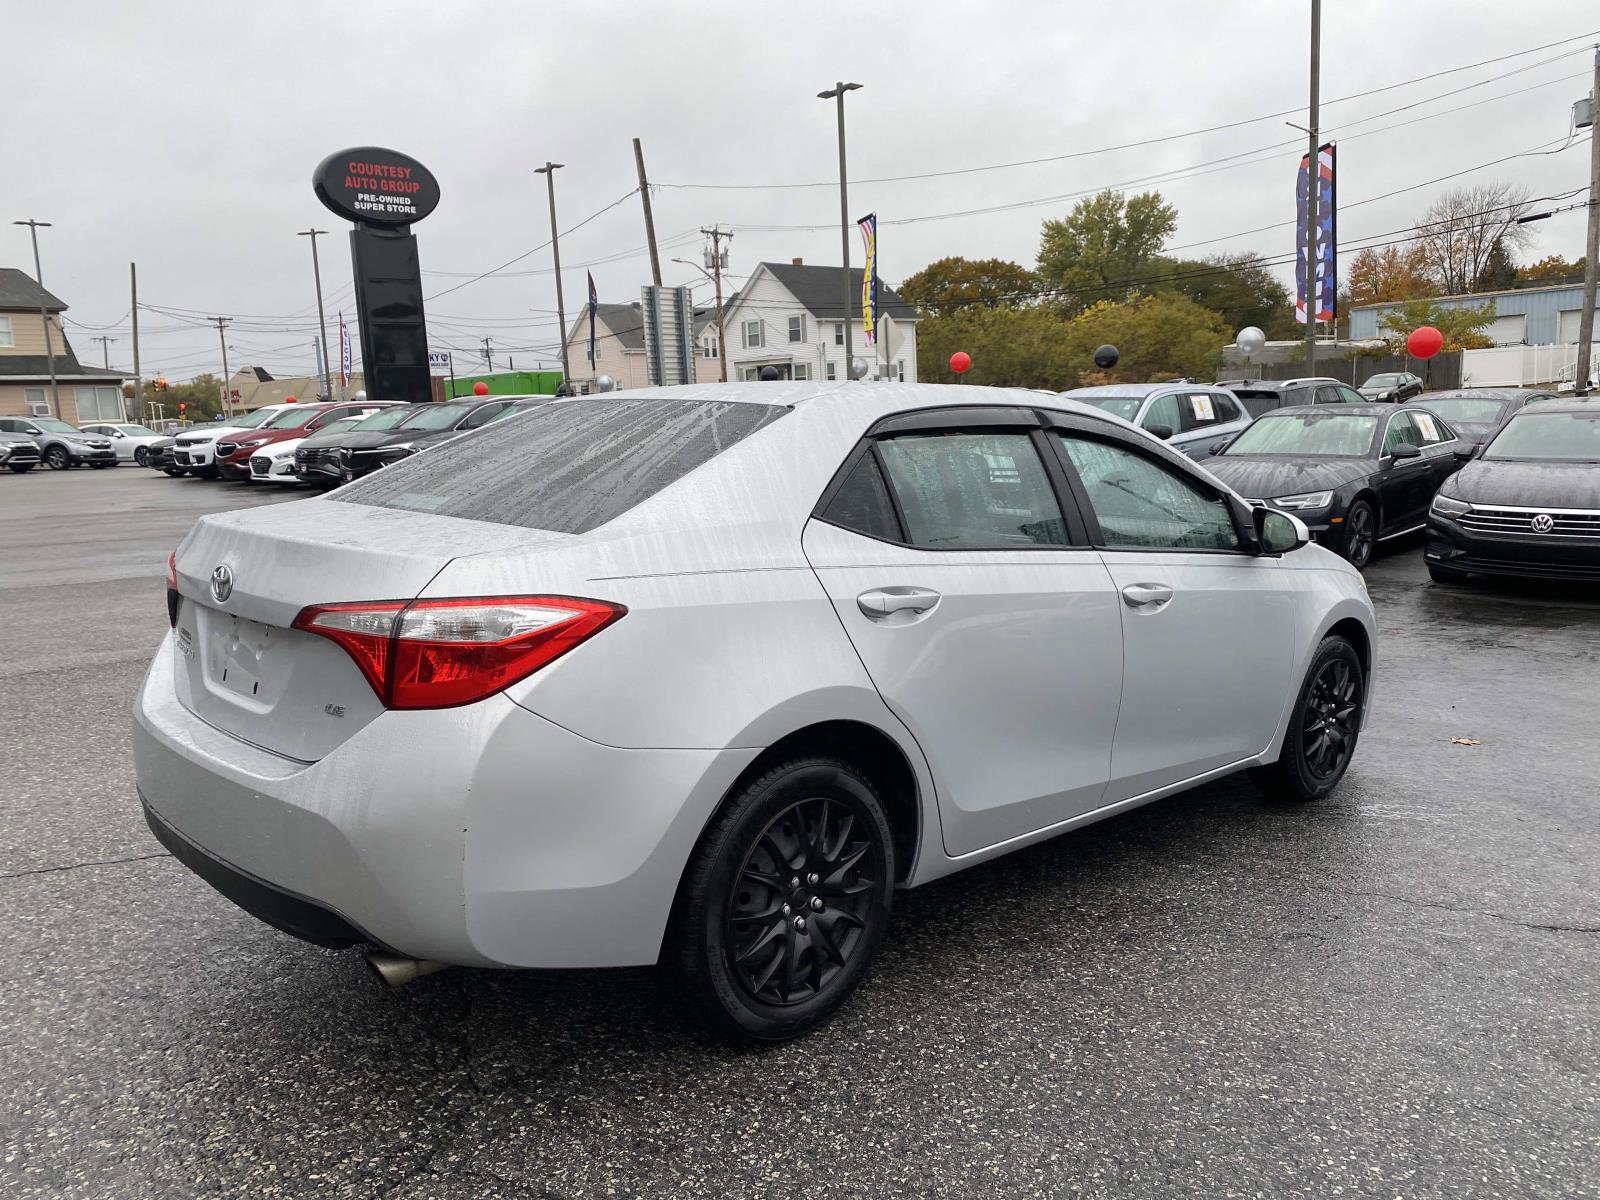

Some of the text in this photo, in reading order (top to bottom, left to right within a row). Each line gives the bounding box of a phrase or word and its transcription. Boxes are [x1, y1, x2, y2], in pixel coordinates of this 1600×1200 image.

[348, 161, 411, 179] COURTESY
[345, 176, 420, 193] AUTO GROUP
[358, 193, 411, 204] PRE-OWNED
[354, 201, 417, 214] SUPER STORE
[342, 323, 350, 379] WELCOME
